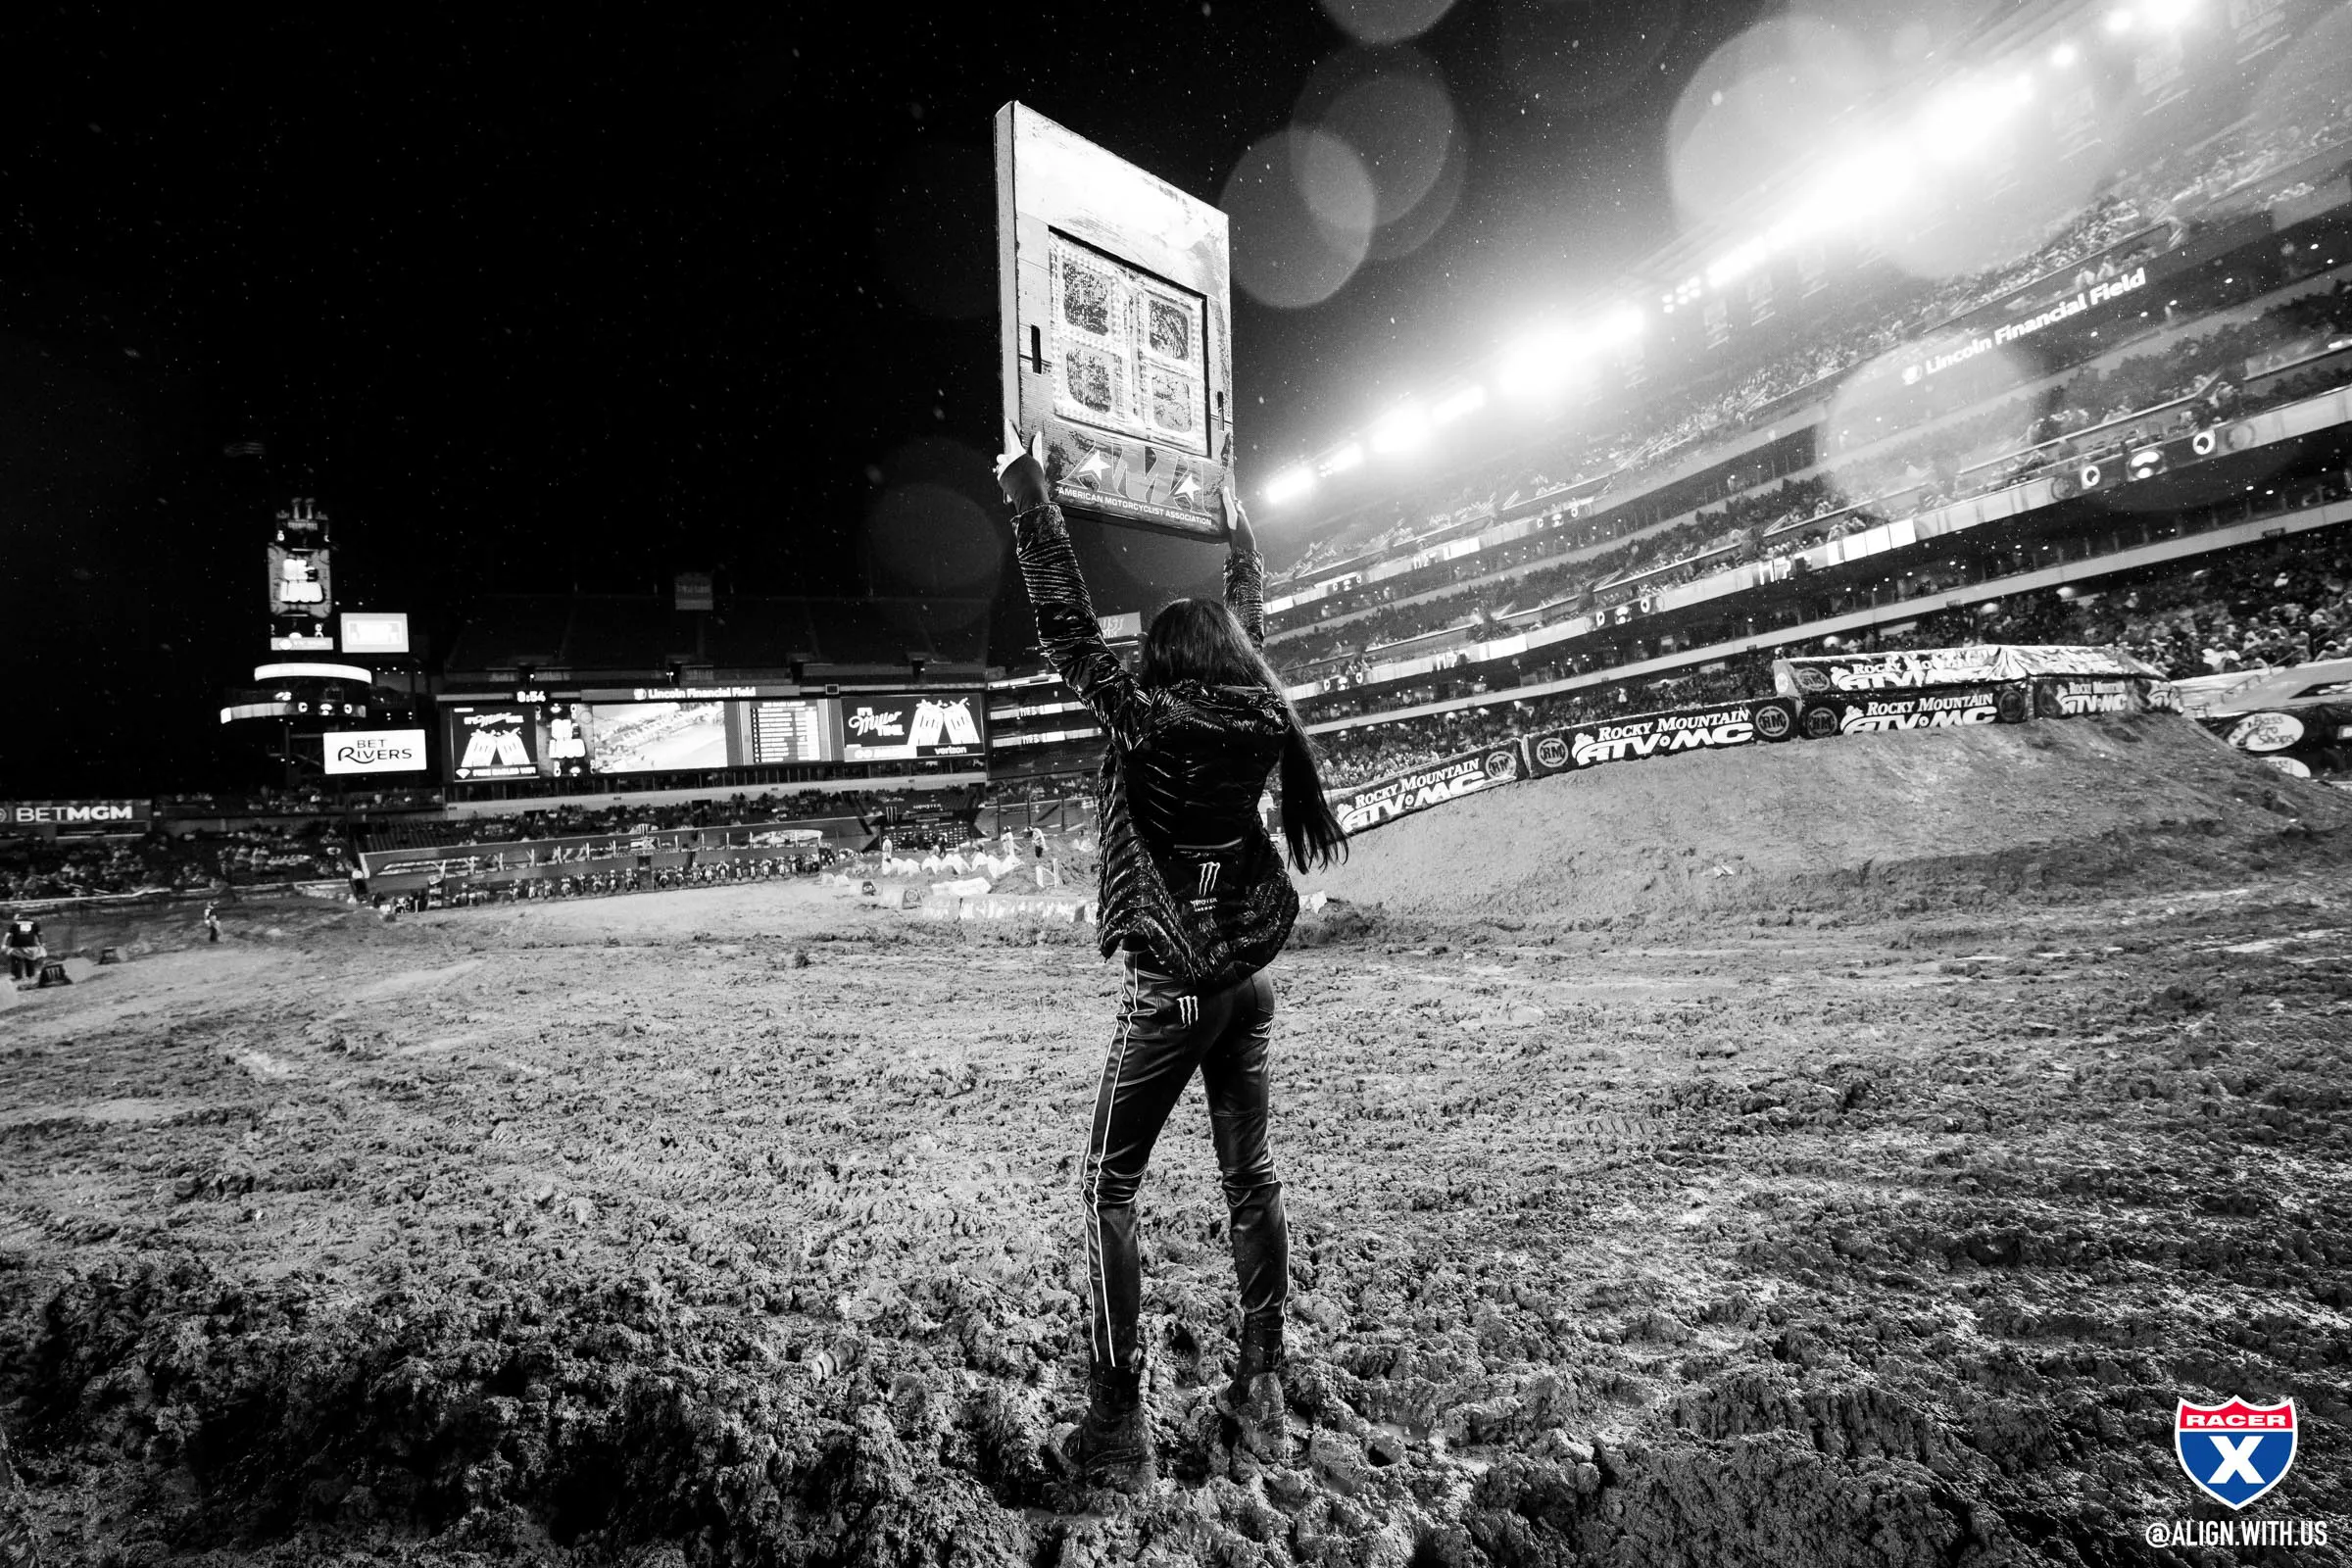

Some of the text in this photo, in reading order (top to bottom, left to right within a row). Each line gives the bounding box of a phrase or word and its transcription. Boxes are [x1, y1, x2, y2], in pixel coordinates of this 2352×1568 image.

[1926, 267, 2146, 375] Lincoln Financial Field
[1057, 487, 1212, 525] AMERICAN MOTORCYCLIST ASSOCIATION
[1852, 662, 1901, 674] ROCKY
[649, 686, 756, 700] Lincoln Financial Field
[1866, 701, 1916, 716] ROCKY
[1919, 693, 1994, 711] MOUNTAIN
[849, 710, 903, 736] Miller
[1597, 718, 1653, 742] ROCKY
[1657, 708, 1750, 732] MOUNTAIN
[2254, 715, 2283, 726] Bass
[357, 739, 387, 749] BET
[2258, 735, 2295, 746] Shops
[337, 747, 413, 763] RIVERS
[934, 746, 967, 756] verizon
[1355, 783, 1399, 809] ROCKY
[1399, 758, 1480, 796] MOUNTAIN
[16, 806, 133, 822] BETMGM
